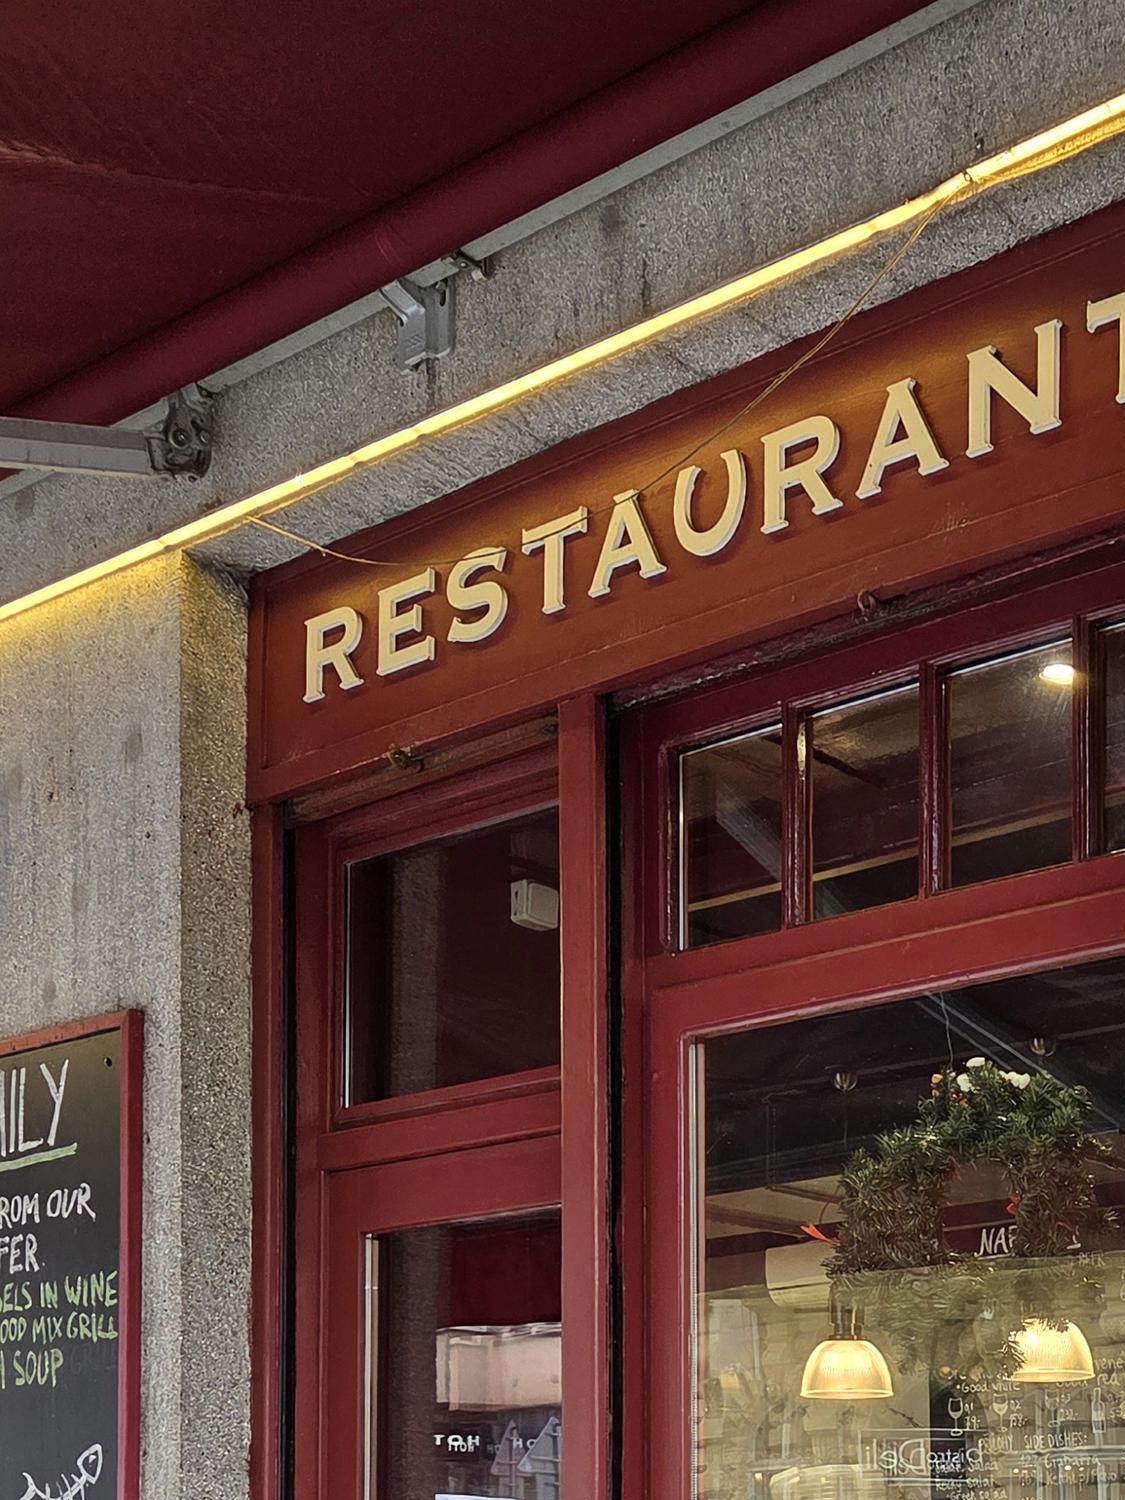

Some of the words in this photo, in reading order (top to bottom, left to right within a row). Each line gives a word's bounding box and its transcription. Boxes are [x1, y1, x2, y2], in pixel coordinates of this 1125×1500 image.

[46, 1182, 97, 1222] OUR
[0, 1281, 32, 1313] ELS
[40, 1279, 58, 1310] IN
[64, 1270, 118, 1308] WINE
[32, 1315, 64, 1345] MIX
[66, 1311, 118, 1344] GRILL
[13, 1348, 64, 1389] SOUP
